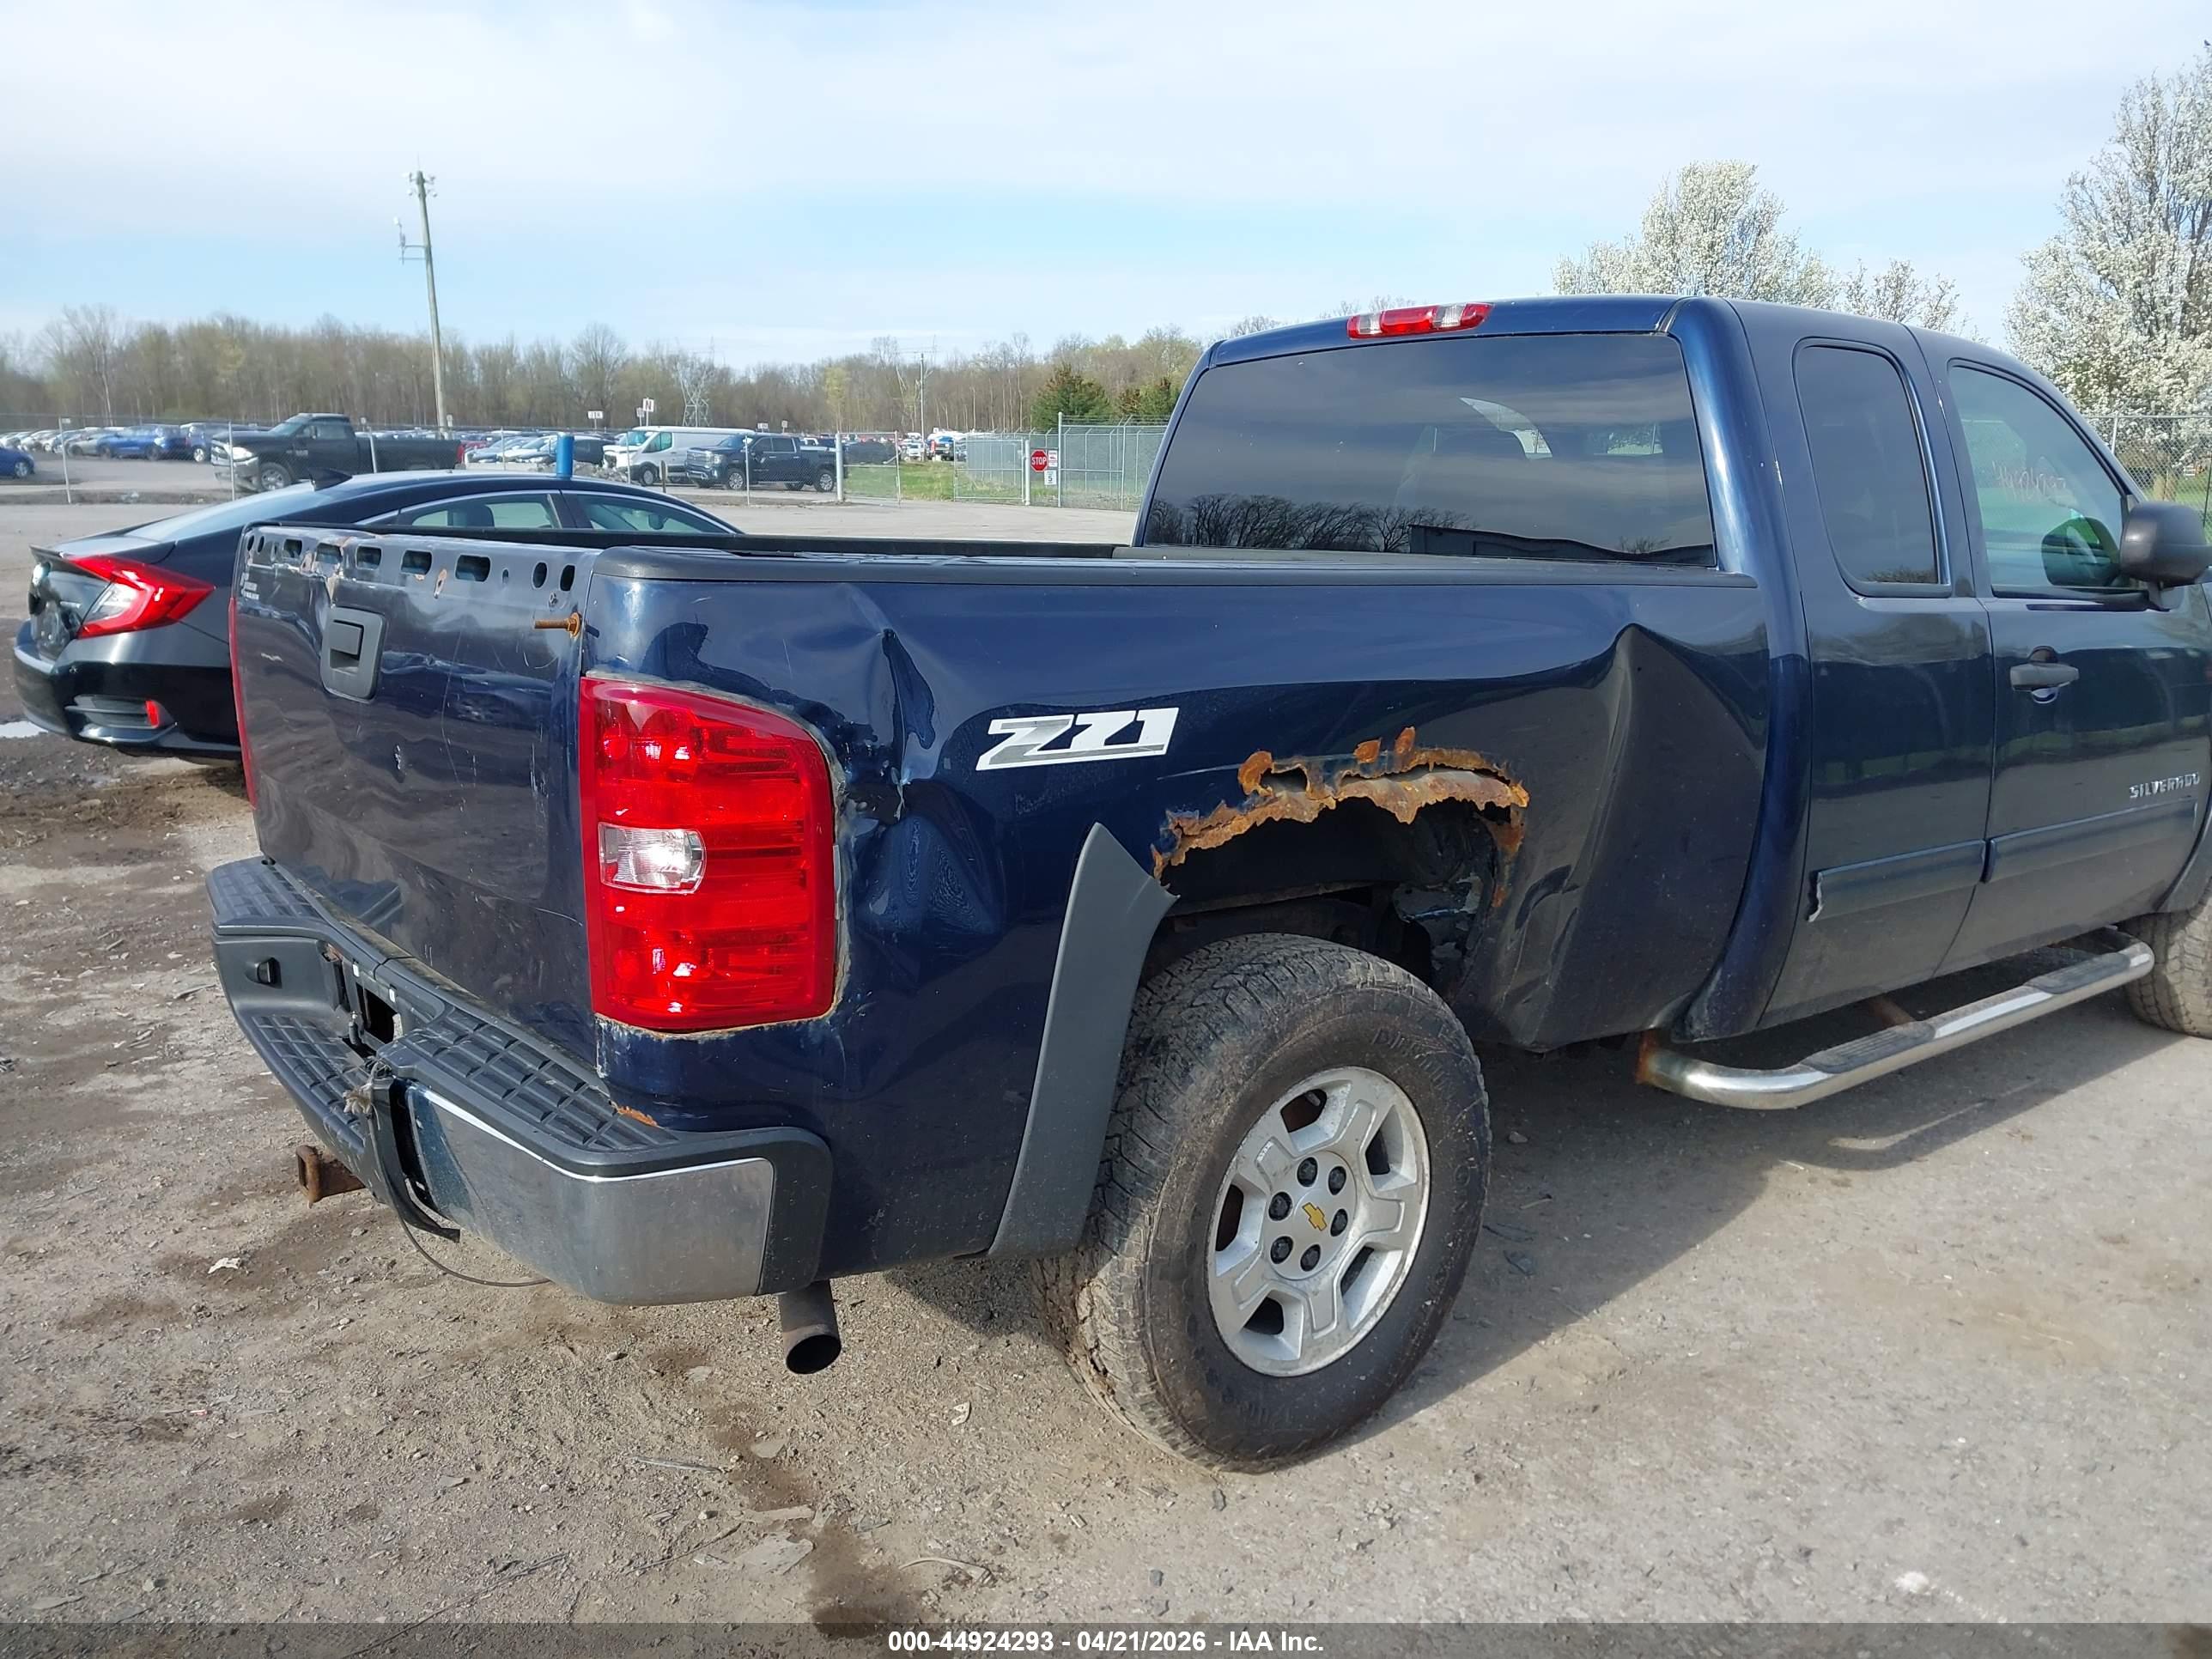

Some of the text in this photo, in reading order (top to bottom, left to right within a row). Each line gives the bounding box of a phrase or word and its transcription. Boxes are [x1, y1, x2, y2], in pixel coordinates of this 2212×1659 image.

[1031, 456, 1046, 465] STOP
[975, 707, 1180, 771] Z71
[2129, 772, 2200, 799] SILVERADO
